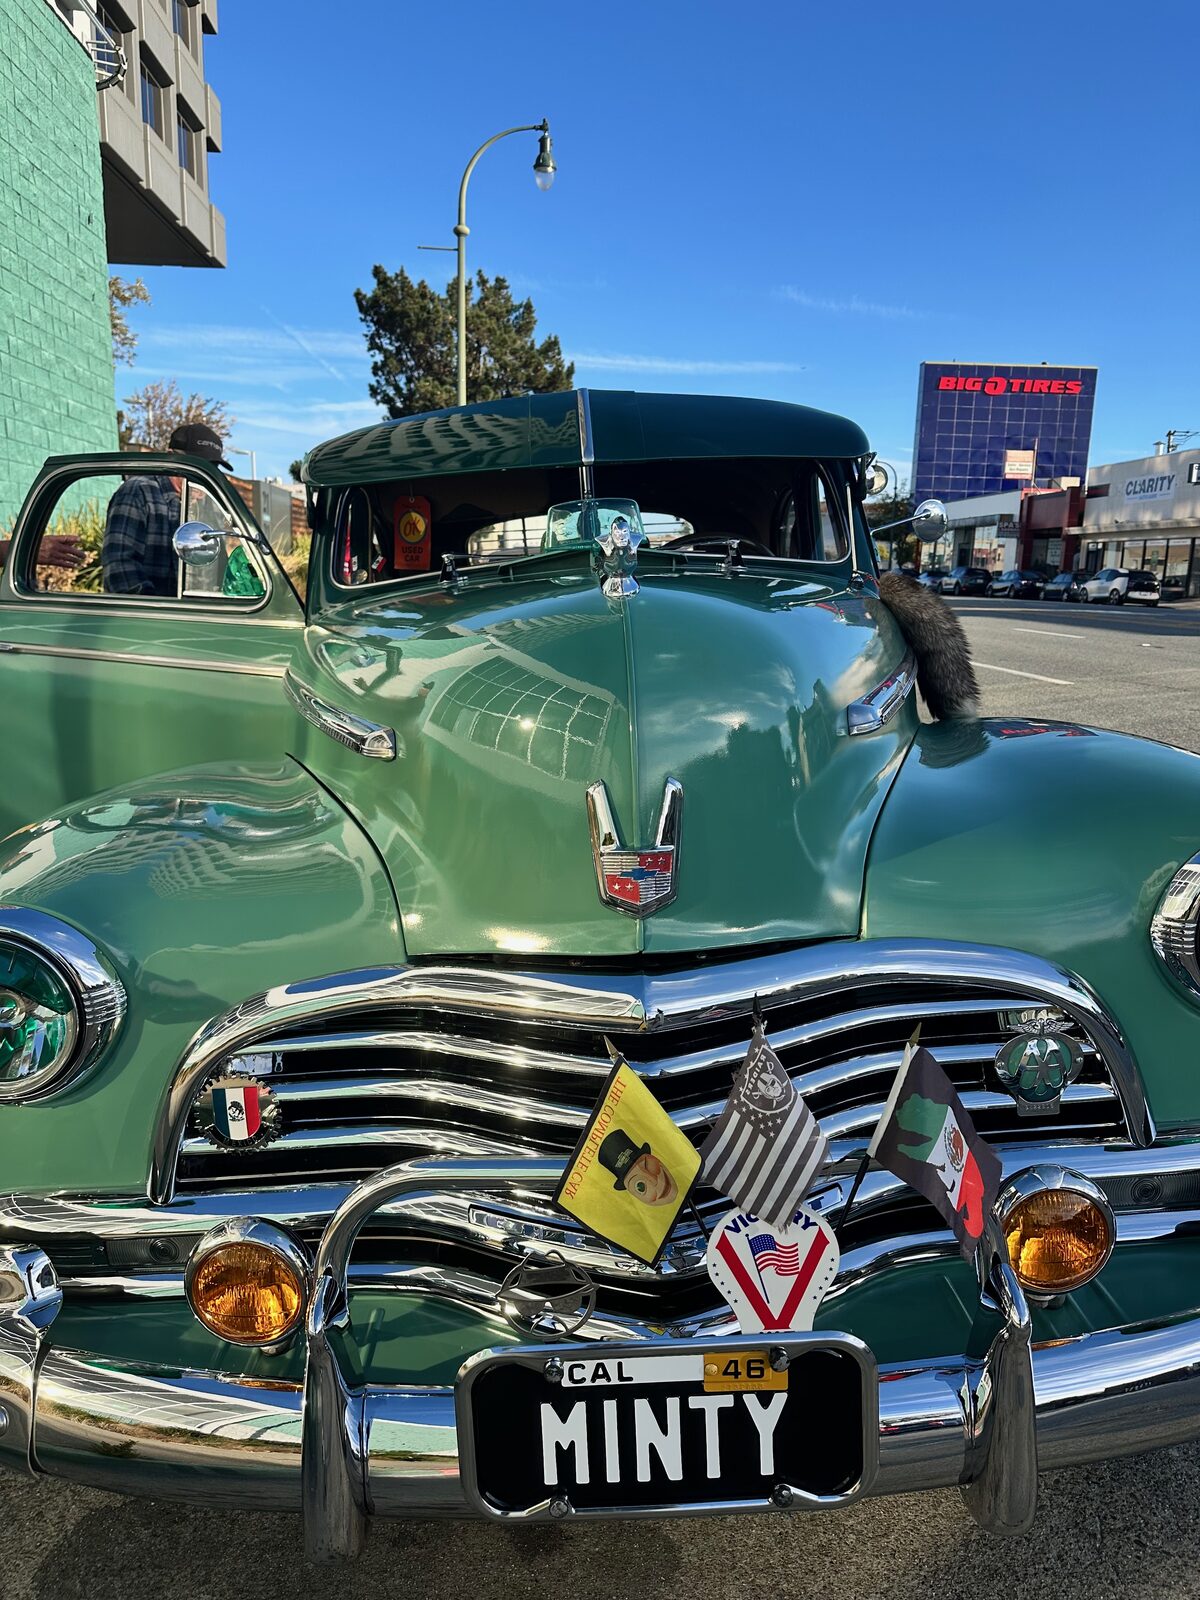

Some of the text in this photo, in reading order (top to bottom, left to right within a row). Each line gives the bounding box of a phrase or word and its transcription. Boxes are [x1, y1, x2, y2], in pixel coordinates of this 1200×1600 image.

[938, 376, 1083, 395] BIG O TIRES
[1125, 474, 1176, 496] CLARITY
[403, 516, 422, 537] OK
[401, 546, 424, 554] USED
[404, 554, 421, 562] CAR
[724, 1208, 819, 1234] VICRY
[568, 1361, 634, 1384] CAL
[722, 1359, 765, 1379] 46
[540, 1392, 788, 1485] MINTY
